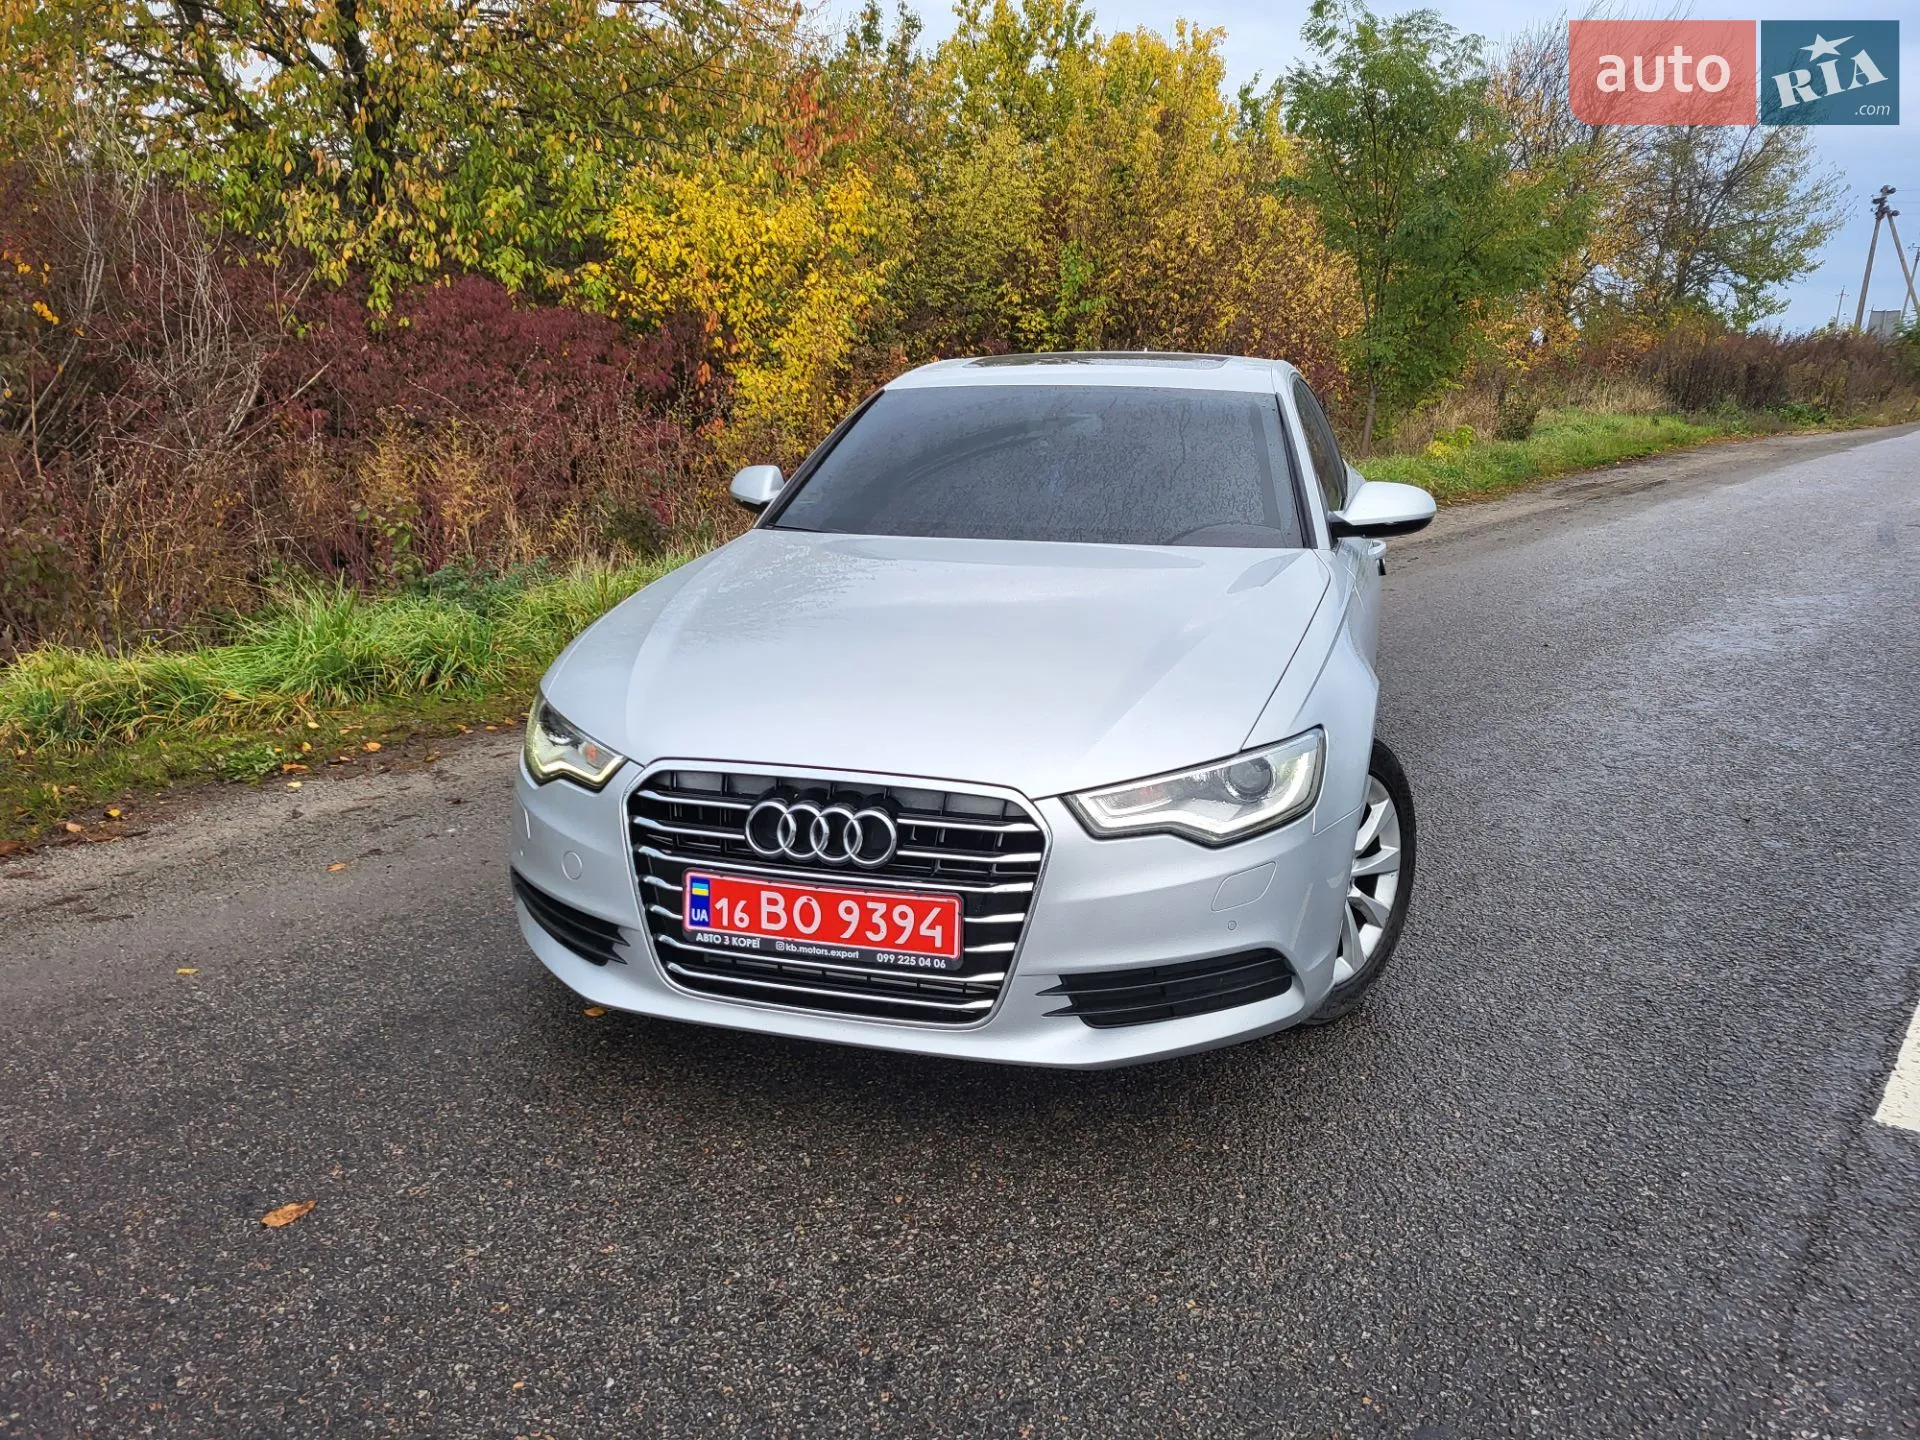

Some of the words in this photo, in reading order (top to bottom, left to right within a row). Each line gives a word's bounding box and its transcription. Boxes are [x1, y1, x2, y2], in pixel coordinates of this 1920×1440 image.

[691, 908, 709, 922] UA
[714, 897, 750, 928] 16
[837, 899, 943, 948] 9394
[696, 932, 721, 945] АВТО
[732, 937, 760, 949] КОРЕЇ
[876, 953, 895, 964] 099
[898, 955, 916, 966] 225
[919, 957, 931, 967] 04
[934, 958, 947, 969] 06
